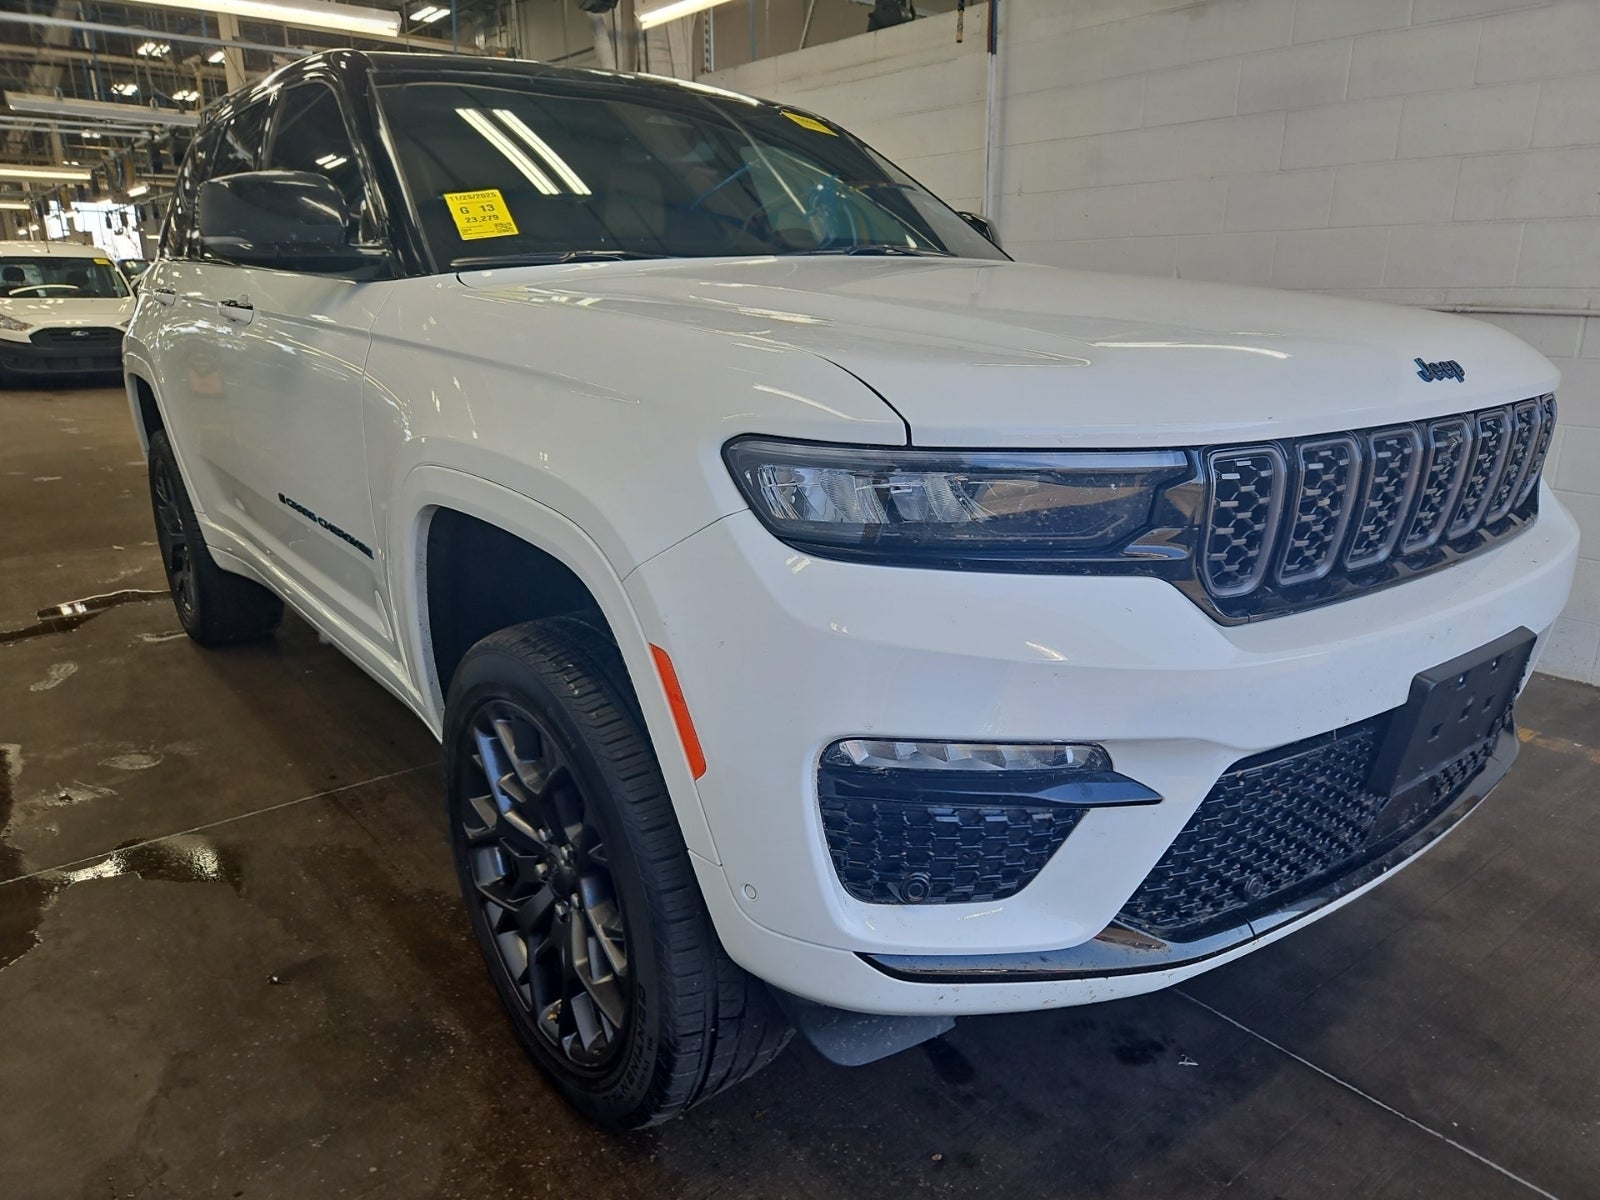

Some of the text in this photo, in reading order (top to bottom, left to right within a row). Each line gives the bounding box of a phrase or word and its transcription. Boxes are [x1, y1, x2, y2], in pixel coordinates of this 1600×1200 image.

[448, 192, 498, 201] 11/25/2025
[460, 204, 495, 215] G 13
[1413, 357, 1465, 383] Jeep
